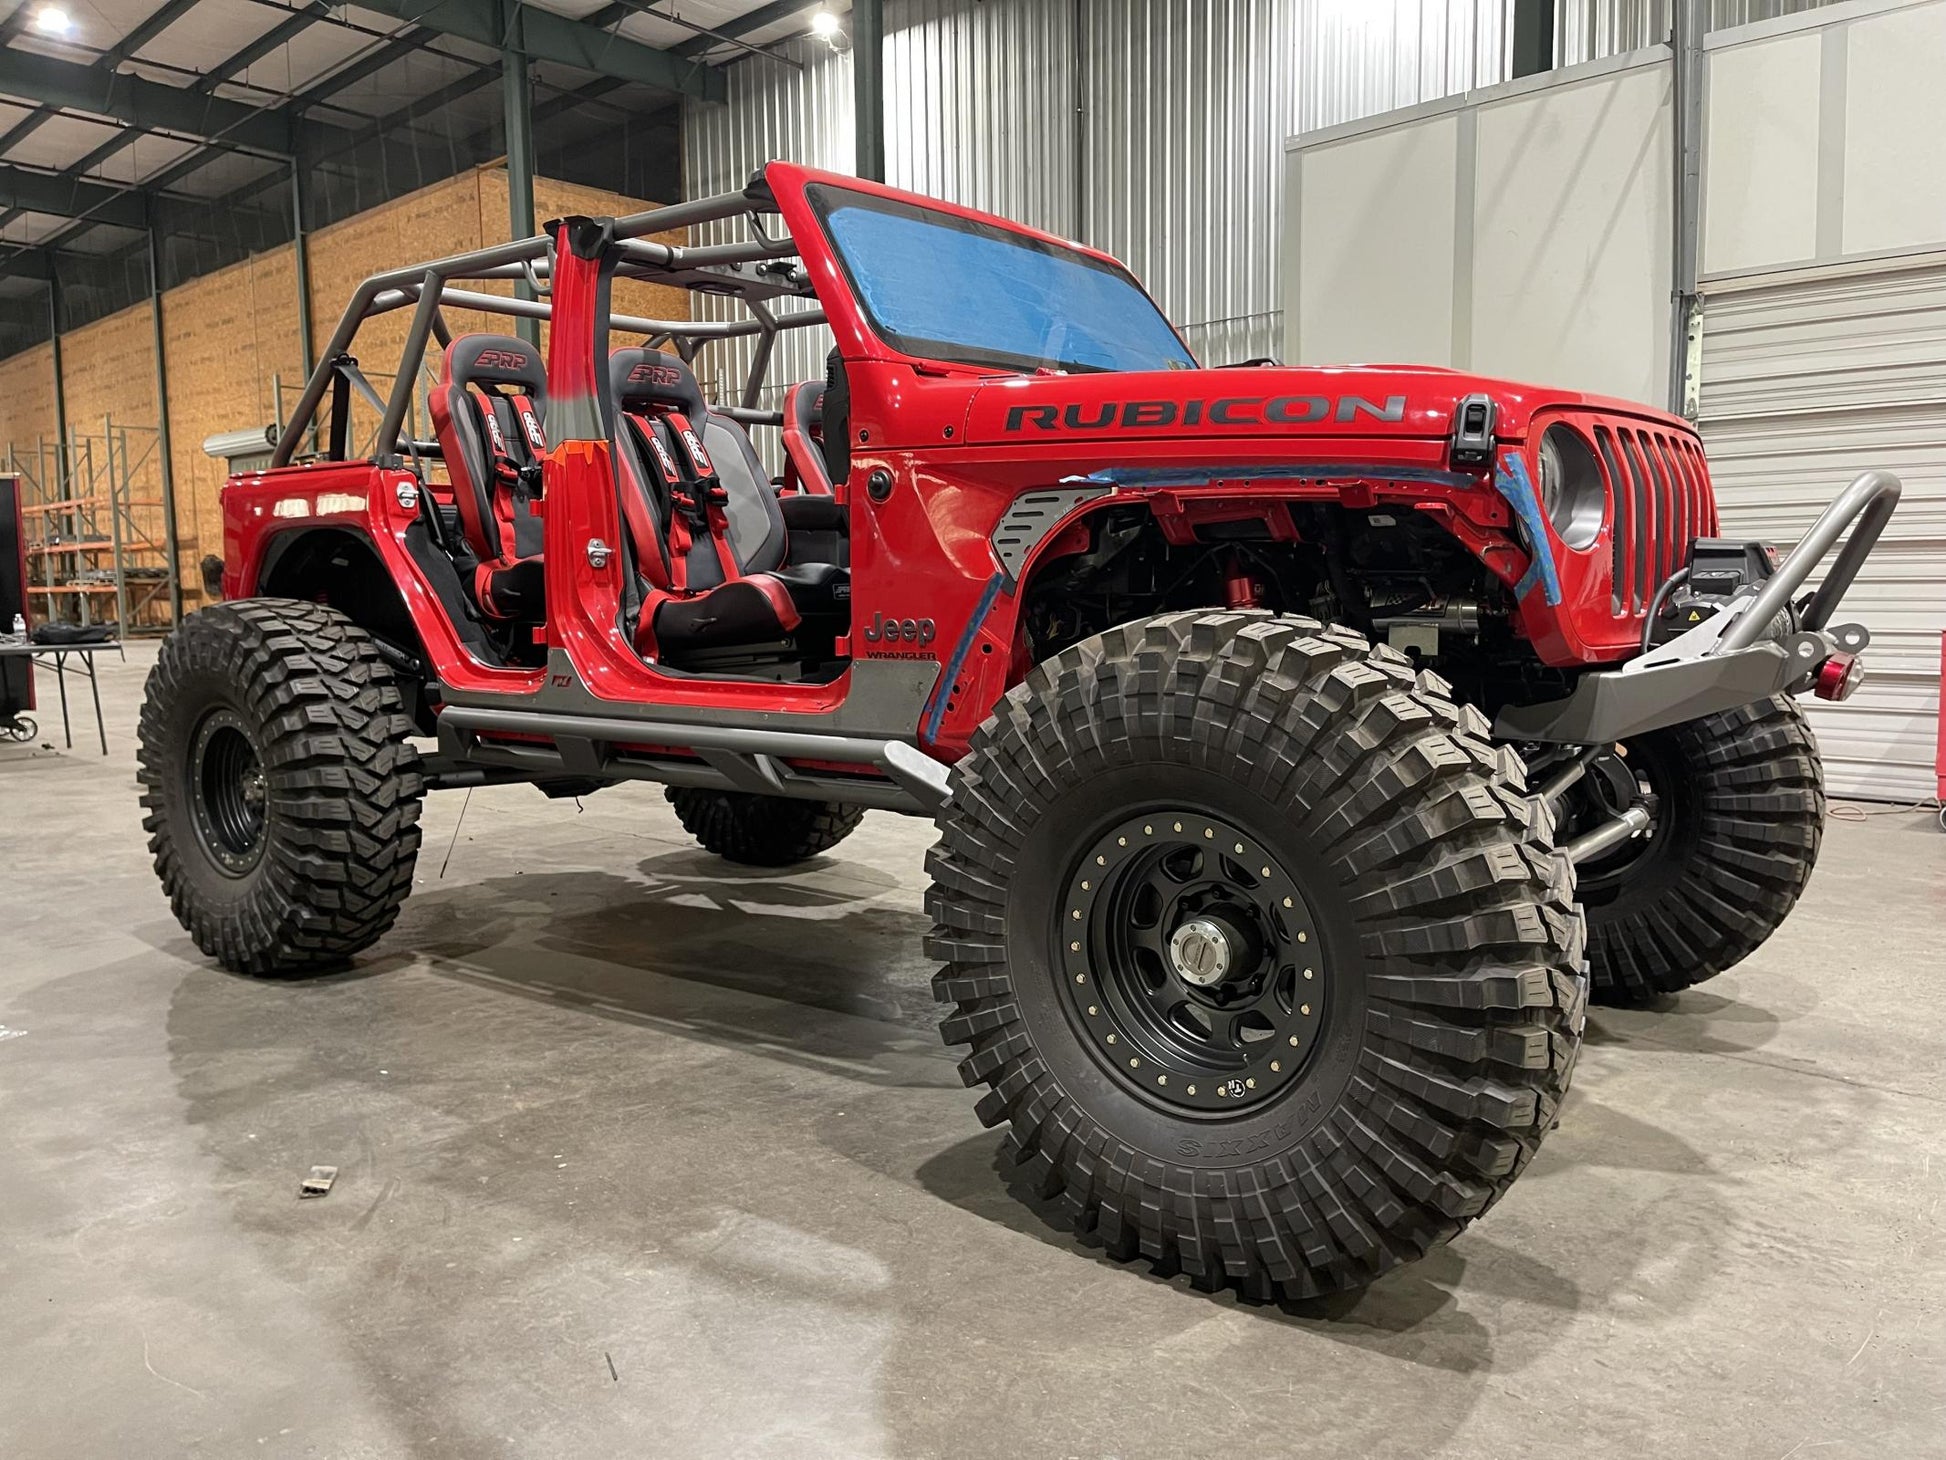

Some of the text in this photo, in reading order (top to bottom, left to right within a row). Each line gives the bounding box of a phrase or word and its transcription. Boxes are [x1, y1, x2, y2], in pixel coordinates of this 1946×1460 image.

[1003, 394, 1409, 433] RUBICON
[864, 611, 936, 648] Jeep
[865, 651, 937, 661] WRANGLER
